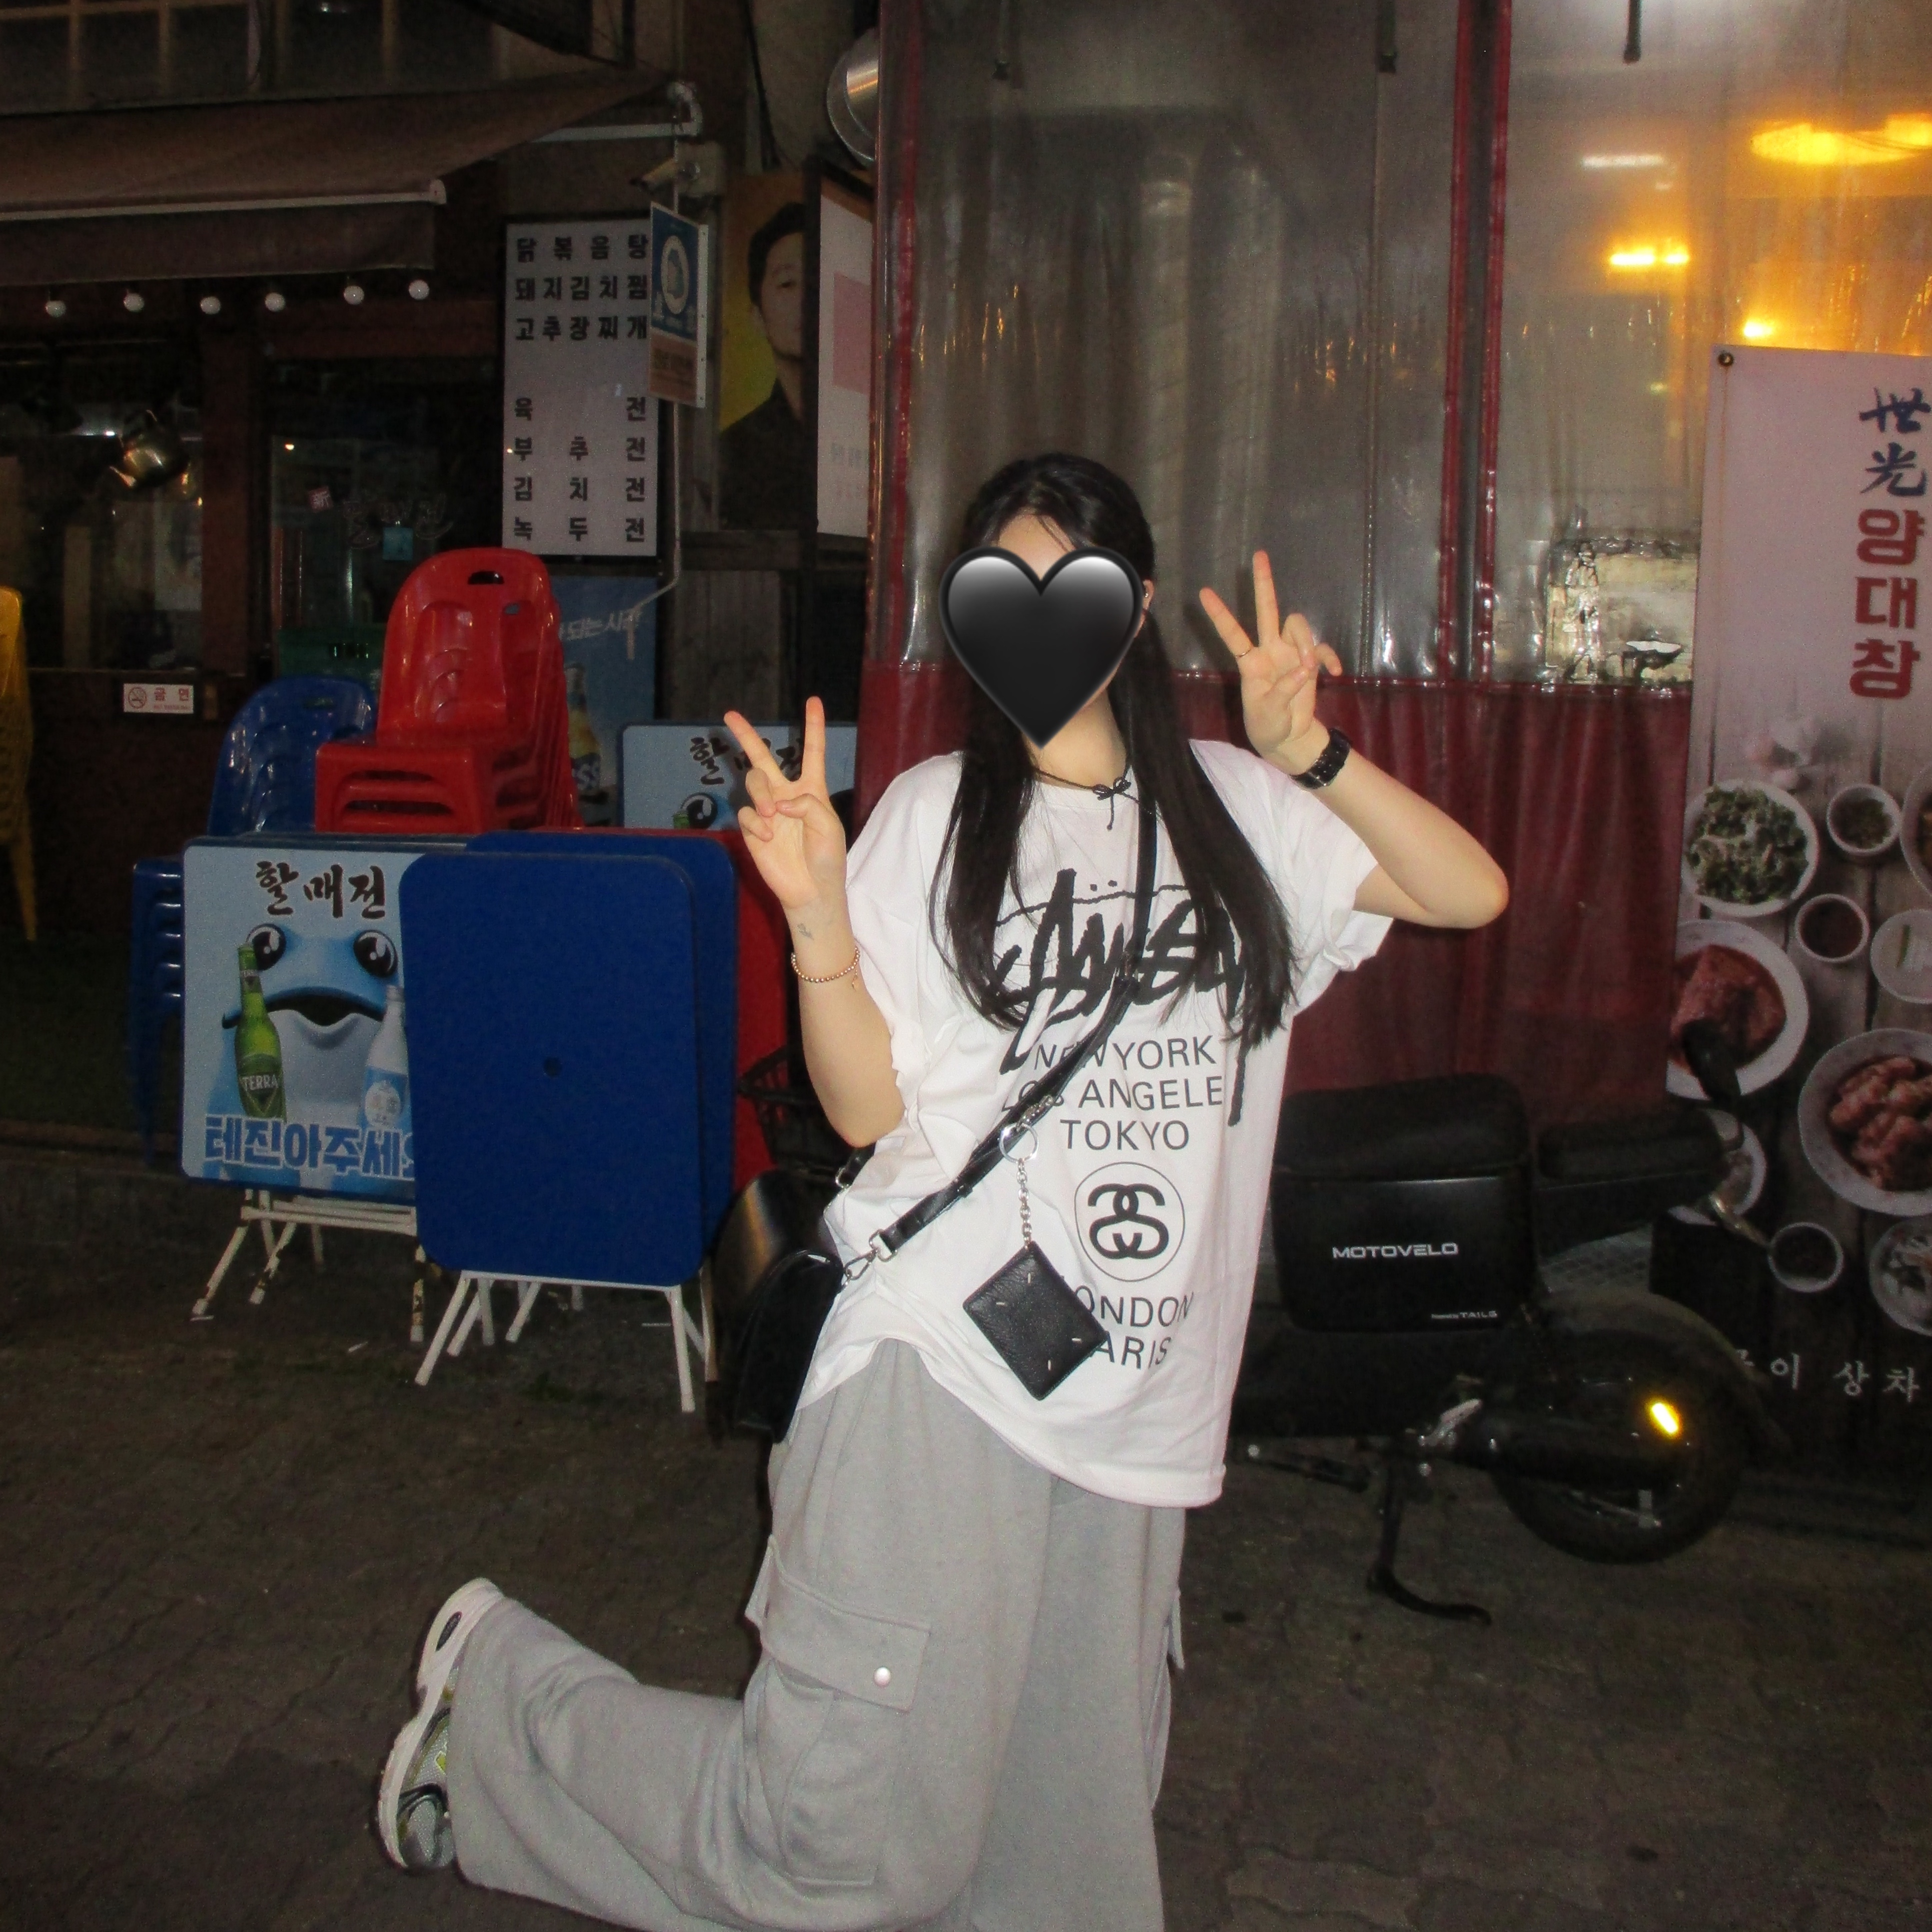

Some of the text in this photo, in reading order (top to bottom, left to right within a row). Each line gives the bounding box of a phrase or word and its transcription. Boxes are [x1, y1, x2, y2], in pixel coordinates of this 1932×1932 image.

[516, 316, 648, 341] 고추장찌개
[256, 860, 385, 918] 할매전
[1112, 1035, 1217, 1071] YORK
[242, 1074, 278, 1090] TERRA
[1060, 1120, 1189, 1150] TOKYO
[1332, 1242, 1458, 1259] MOTOVELO
[1074, 1284, 1194, 1327] ONDON
[1093, 1330, 1171, 1370] ARIS
